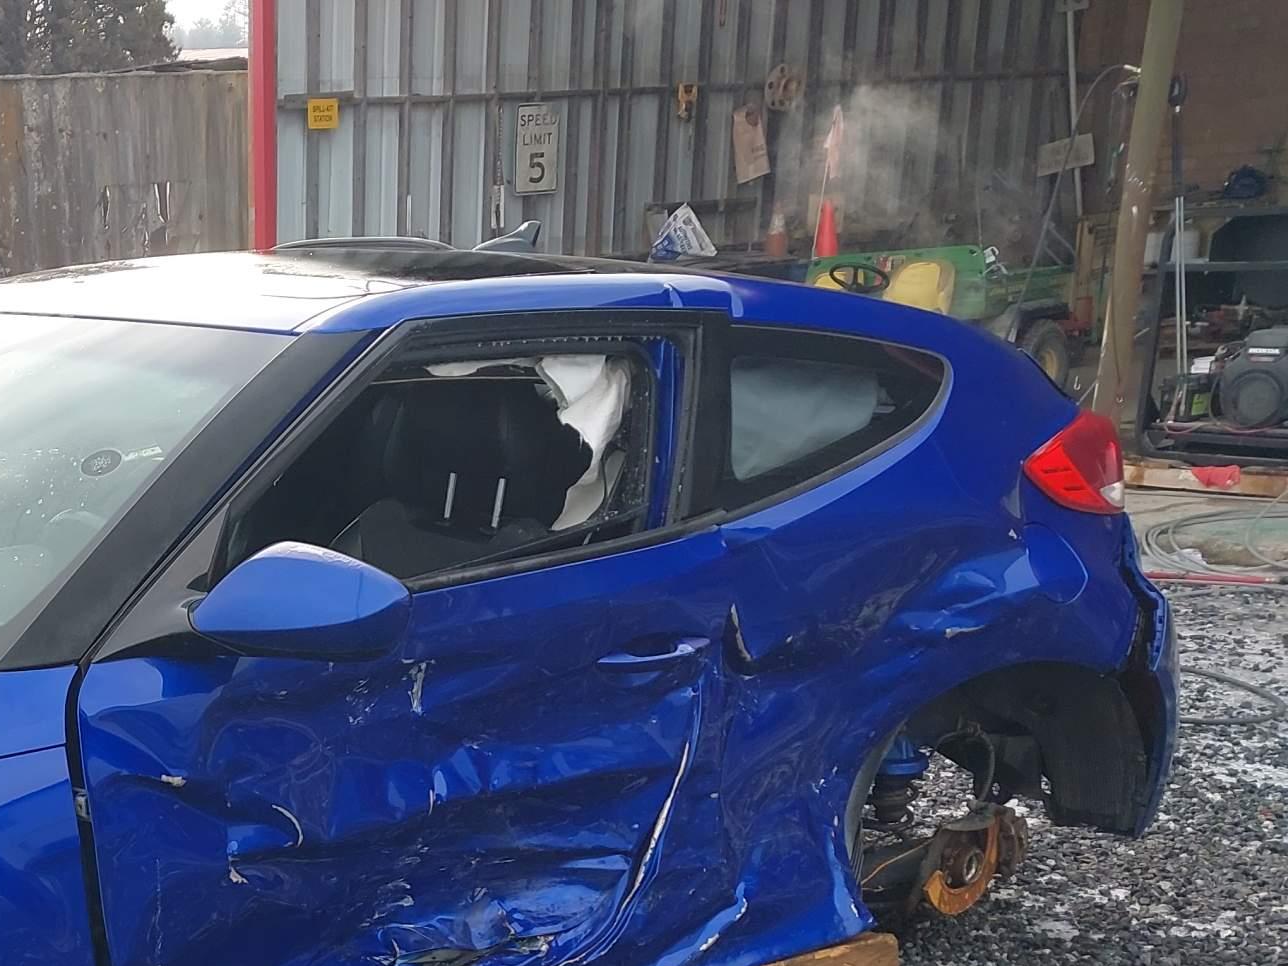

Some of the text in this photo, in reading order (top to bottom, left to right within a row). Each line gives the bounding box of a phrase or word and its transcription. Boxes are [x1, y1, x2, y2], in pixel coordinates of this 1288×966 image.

[520, 113, 558, 127] SPEED
[522, 132, 552, 146] LIMIT
[529, 152, 545, 183] 5
